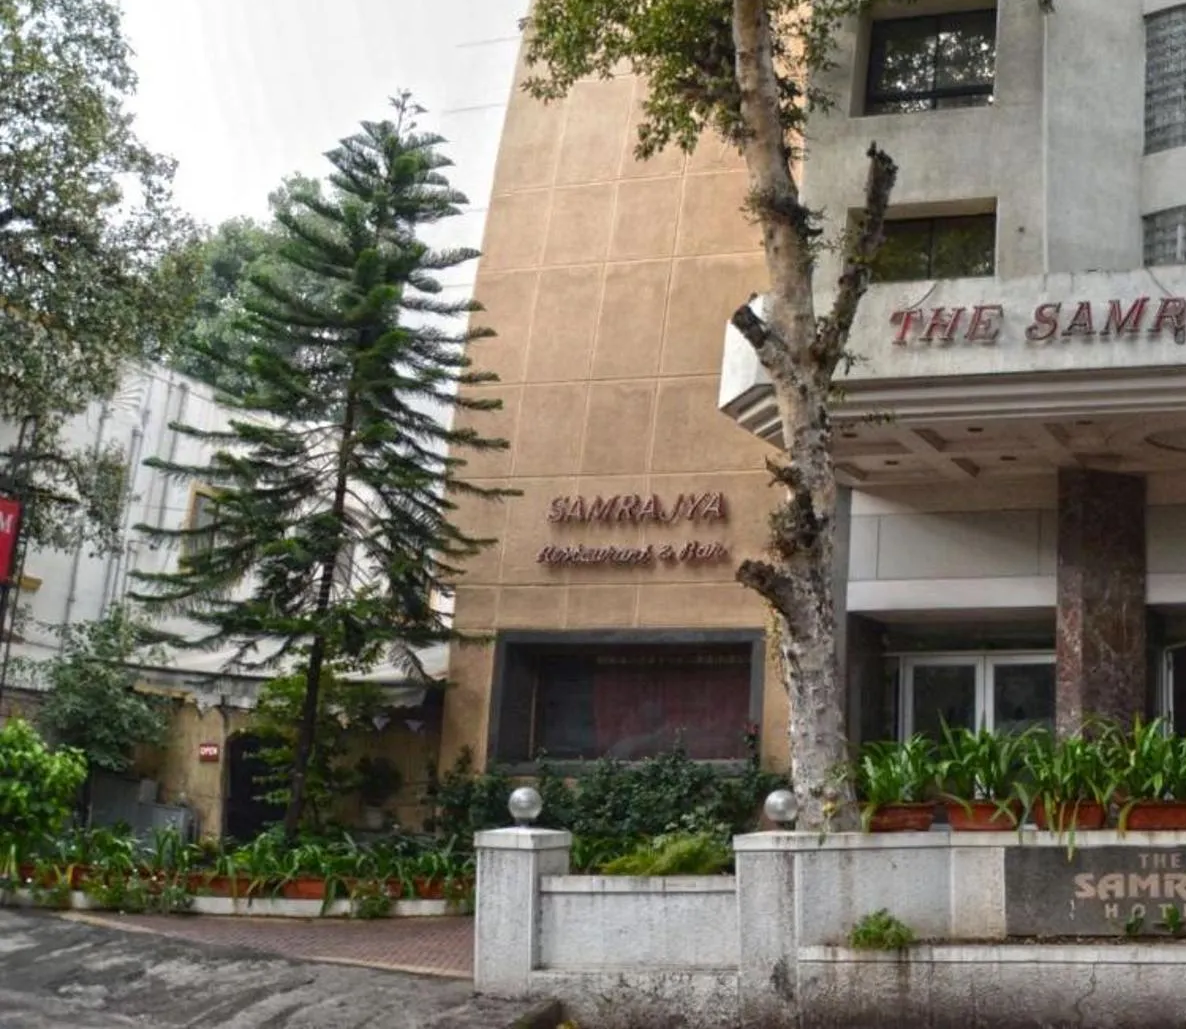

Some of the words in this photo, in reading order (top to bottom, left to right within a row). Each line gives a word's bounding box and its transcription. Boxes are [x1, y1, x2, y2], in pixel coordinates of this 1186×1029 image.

[891, 304, 1003, 346] THE
[548, 491, 728, 524] SAMRAJYA
[1138, 852, 1182, 869] THE
